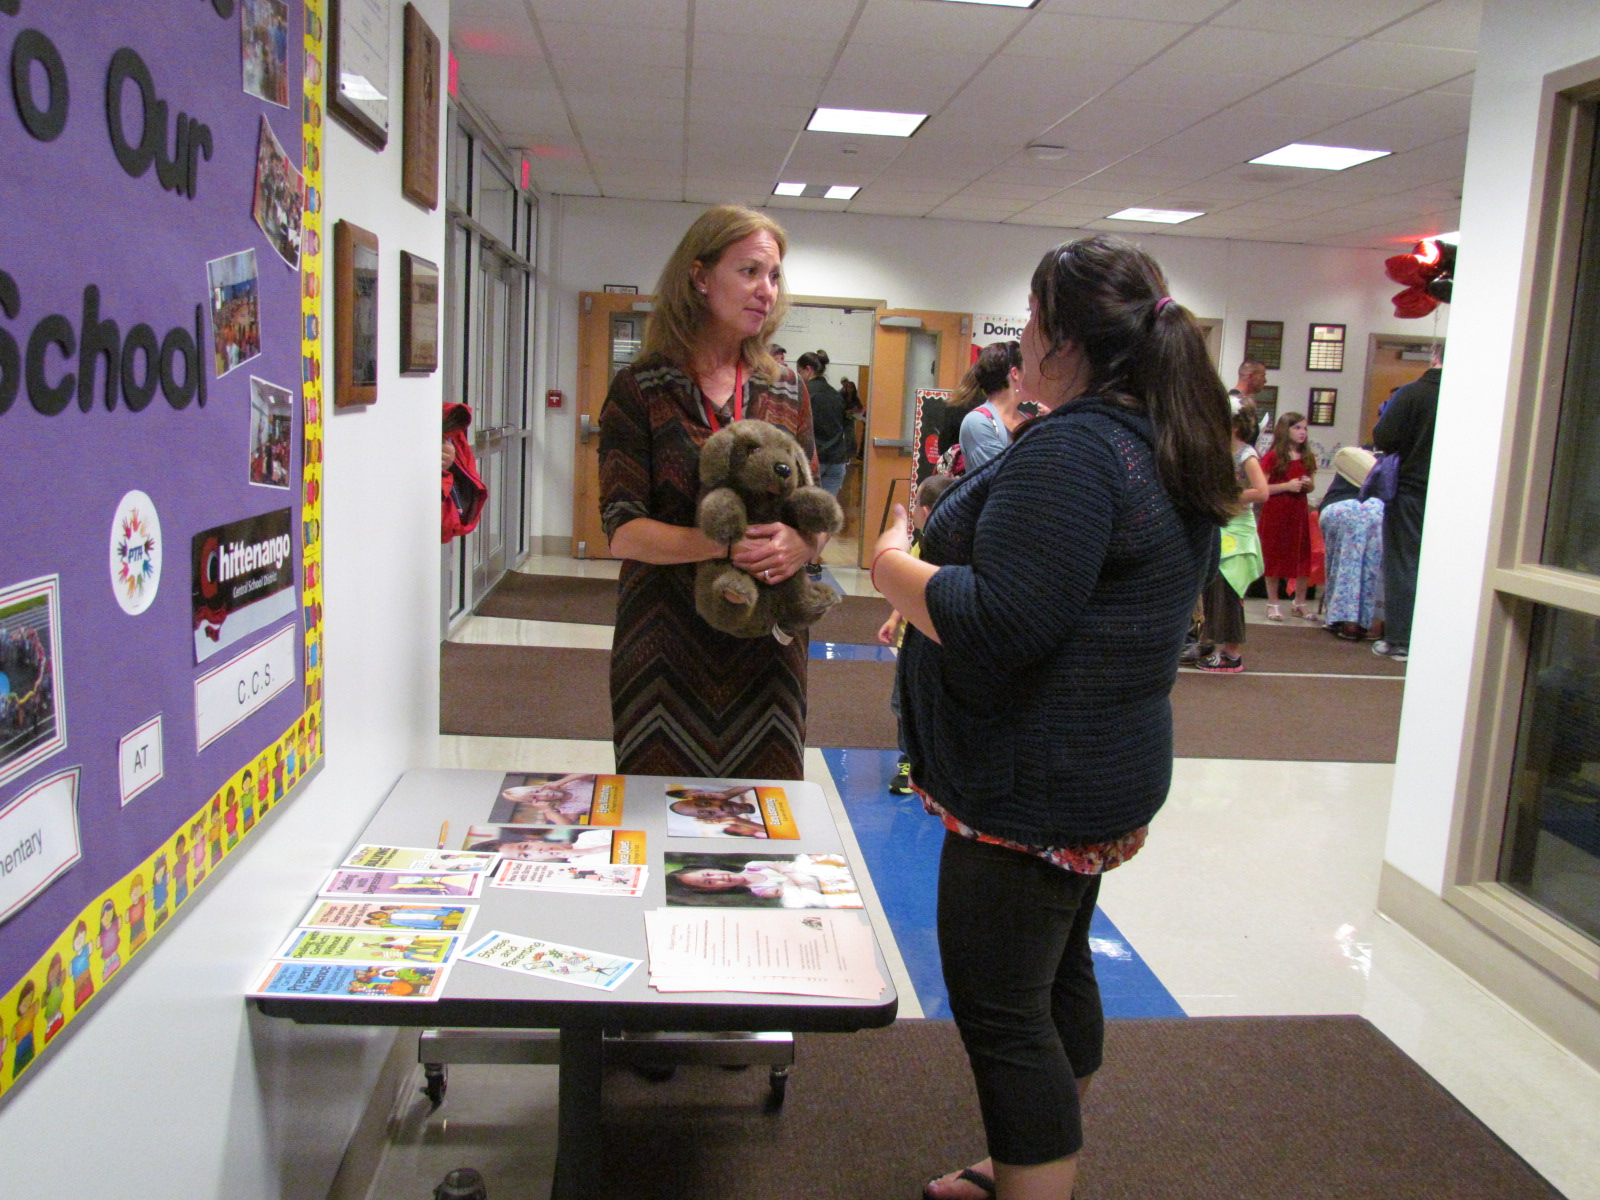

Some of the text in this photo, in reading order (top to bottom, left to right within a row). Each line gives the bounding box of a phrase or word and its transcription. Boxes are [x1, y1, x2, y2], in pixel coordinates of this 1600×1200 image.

[106, 46, 213, 200] Our
[983, 322, 1024, 340] Doing
[128, 545, 143, 564] PTA
[201, 534, 290, 598] Chittenango
[232, 571, 278, 598] Central School District
[238, 663, 275, 704] C.C.S.
[133, 744, 149, 773] AT
[363, 847, 391, 867] BULLYING
[618, 854, 630, 865] oice
[337, 874, 359, 890] Dealing
[356, 877, 369, 887] with
[362, 872, 384, 894] Depression
[292, 931, 320, 958] Dealing with
[309, 935, 331, 955] Conflicts
[321, 936, 343, 955] Without
[335, 936, 356, 955] Violence
[477, 939, 510, 958] Stress
[501, 946, 519, 957] and
[501, 942, 545, 967] Parenting
[287, 967, 315, 991] Prevent
[303, 966, 331, 992] Violence
